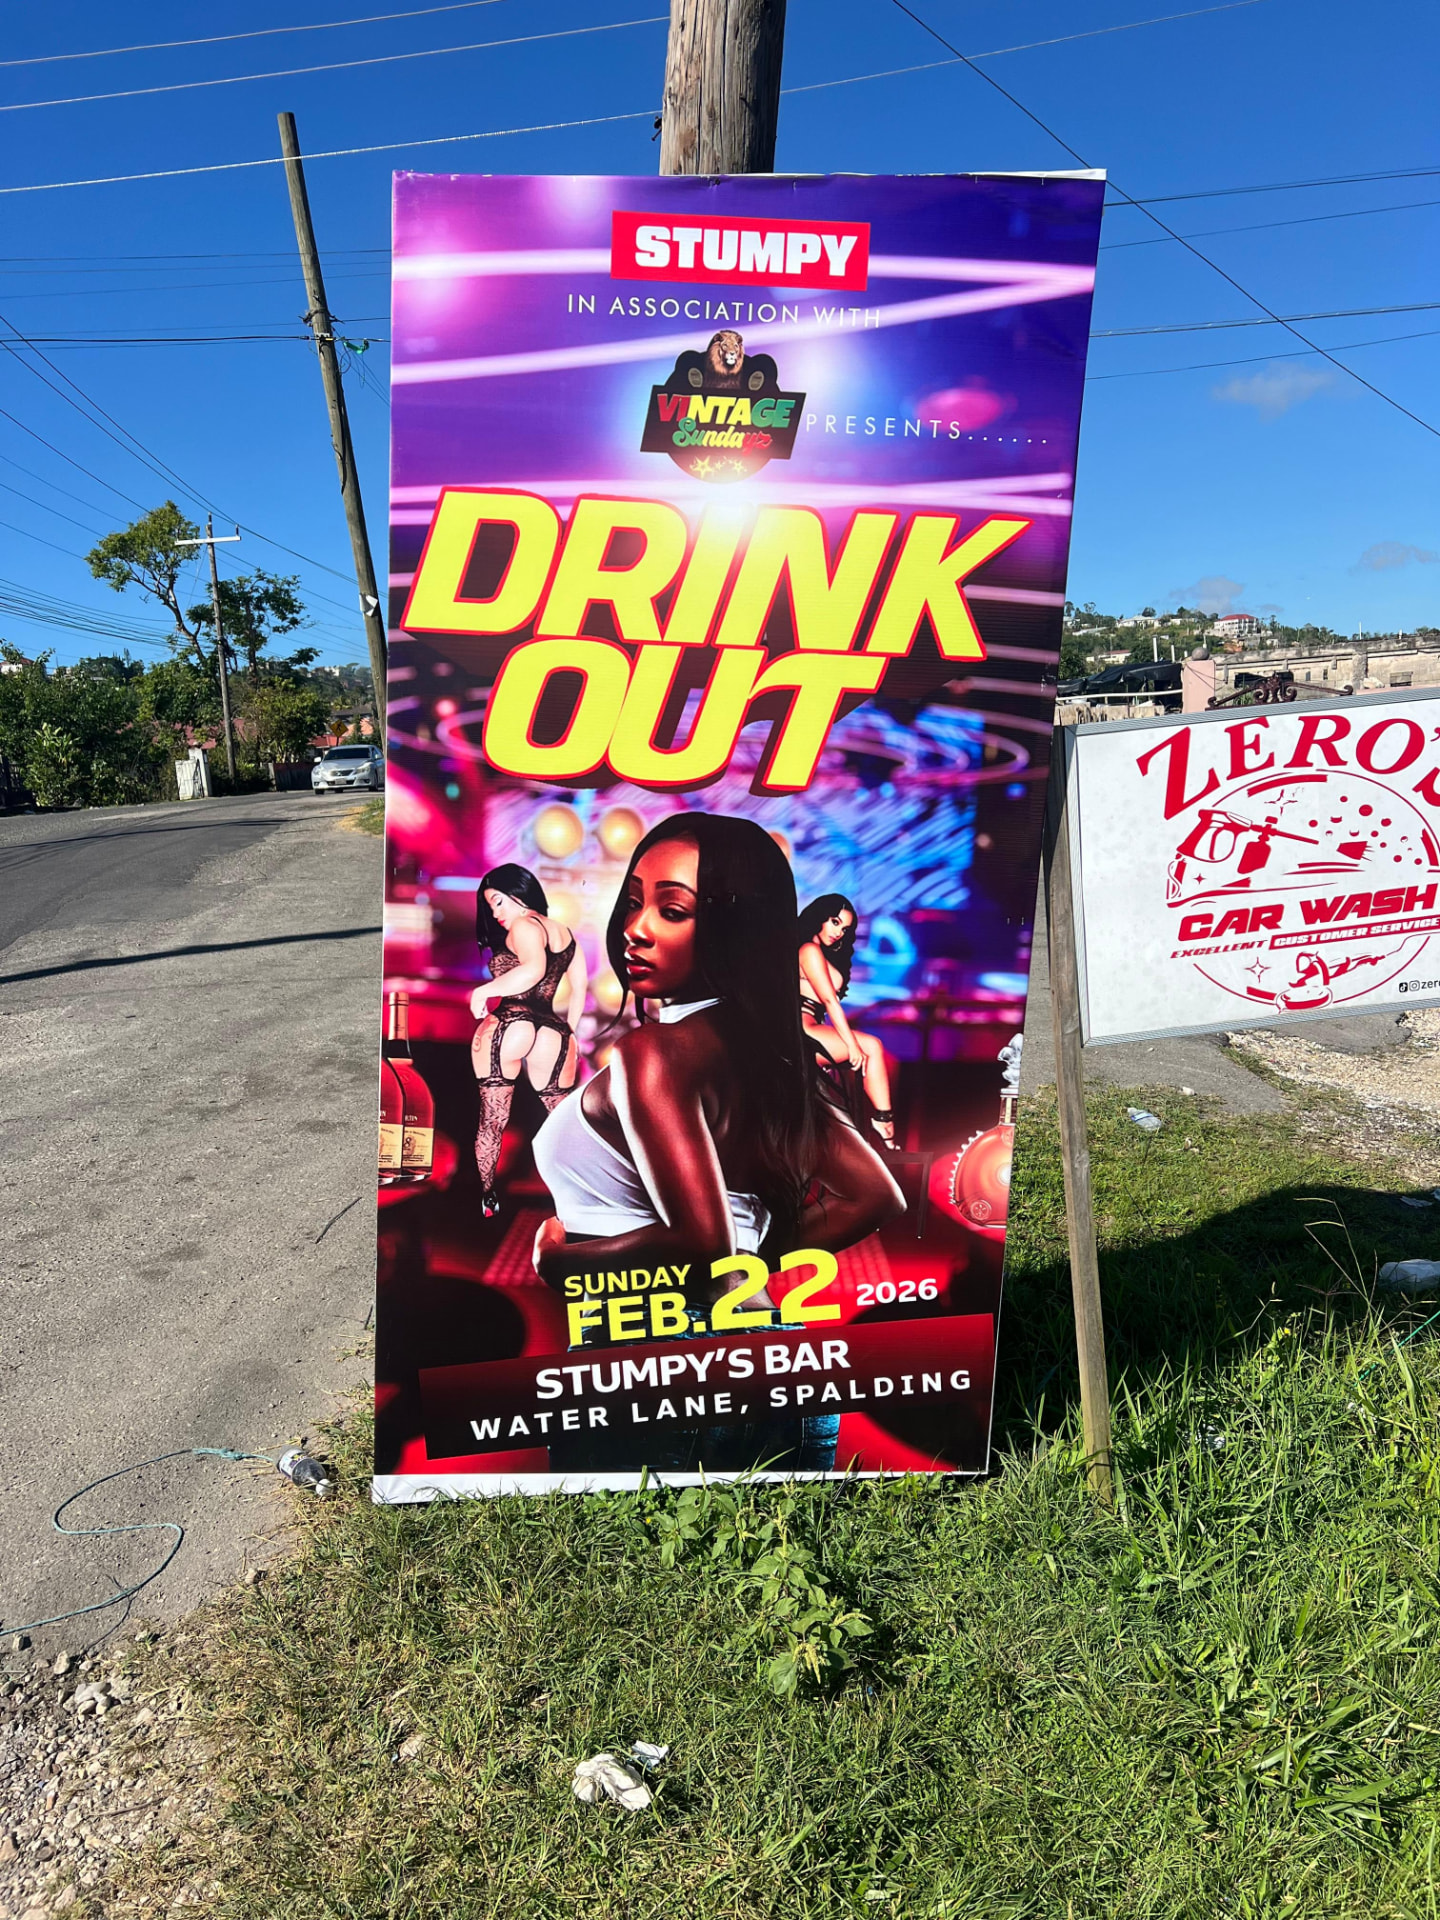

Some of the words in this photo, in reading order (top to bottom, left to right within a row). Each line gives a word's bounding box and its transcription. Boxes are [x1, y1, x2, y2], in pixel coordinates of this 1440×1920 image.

[634, 225, 858, 277] STUMPY
[567, 294, 596, 315] IN
[608, 296, 800, 324] ASSOCIATION
[812, 306, 881, 328] WITH
[656, 393, 796, 429] VINTAGE
[672, 416, 773, 456] Sundayz
[401, 486, 1033, 662] DRINK
[482, 637, 891, 790] OUT
[1170, 939, 1268, 959] EXCELLENT
[1273, 927, 1368, 948] CUSTOMER
[1369, 917, 1440, 935] SERVICE
[1178, 903, 1285, 941] CAR
[1299, 883, 1439, 925] WASH
[1421, 979, 1440, 990] zer
[564, 1264, 691, 1298] SUNDAY
[566, 1292, 706, 1347] FEB.
[710, 1248, 842, 1331] 22
[855, 1277, 939, 1307] 2026
[535, 1347, 754, 1400] STUMPY'S
[764, 1339, 851, 1376] BAR
[470, 1405, 610, 1441] WATER
[631, 1392, 750, 1425] LANE,
[769, 1369, 973, 1408] SPALDING
